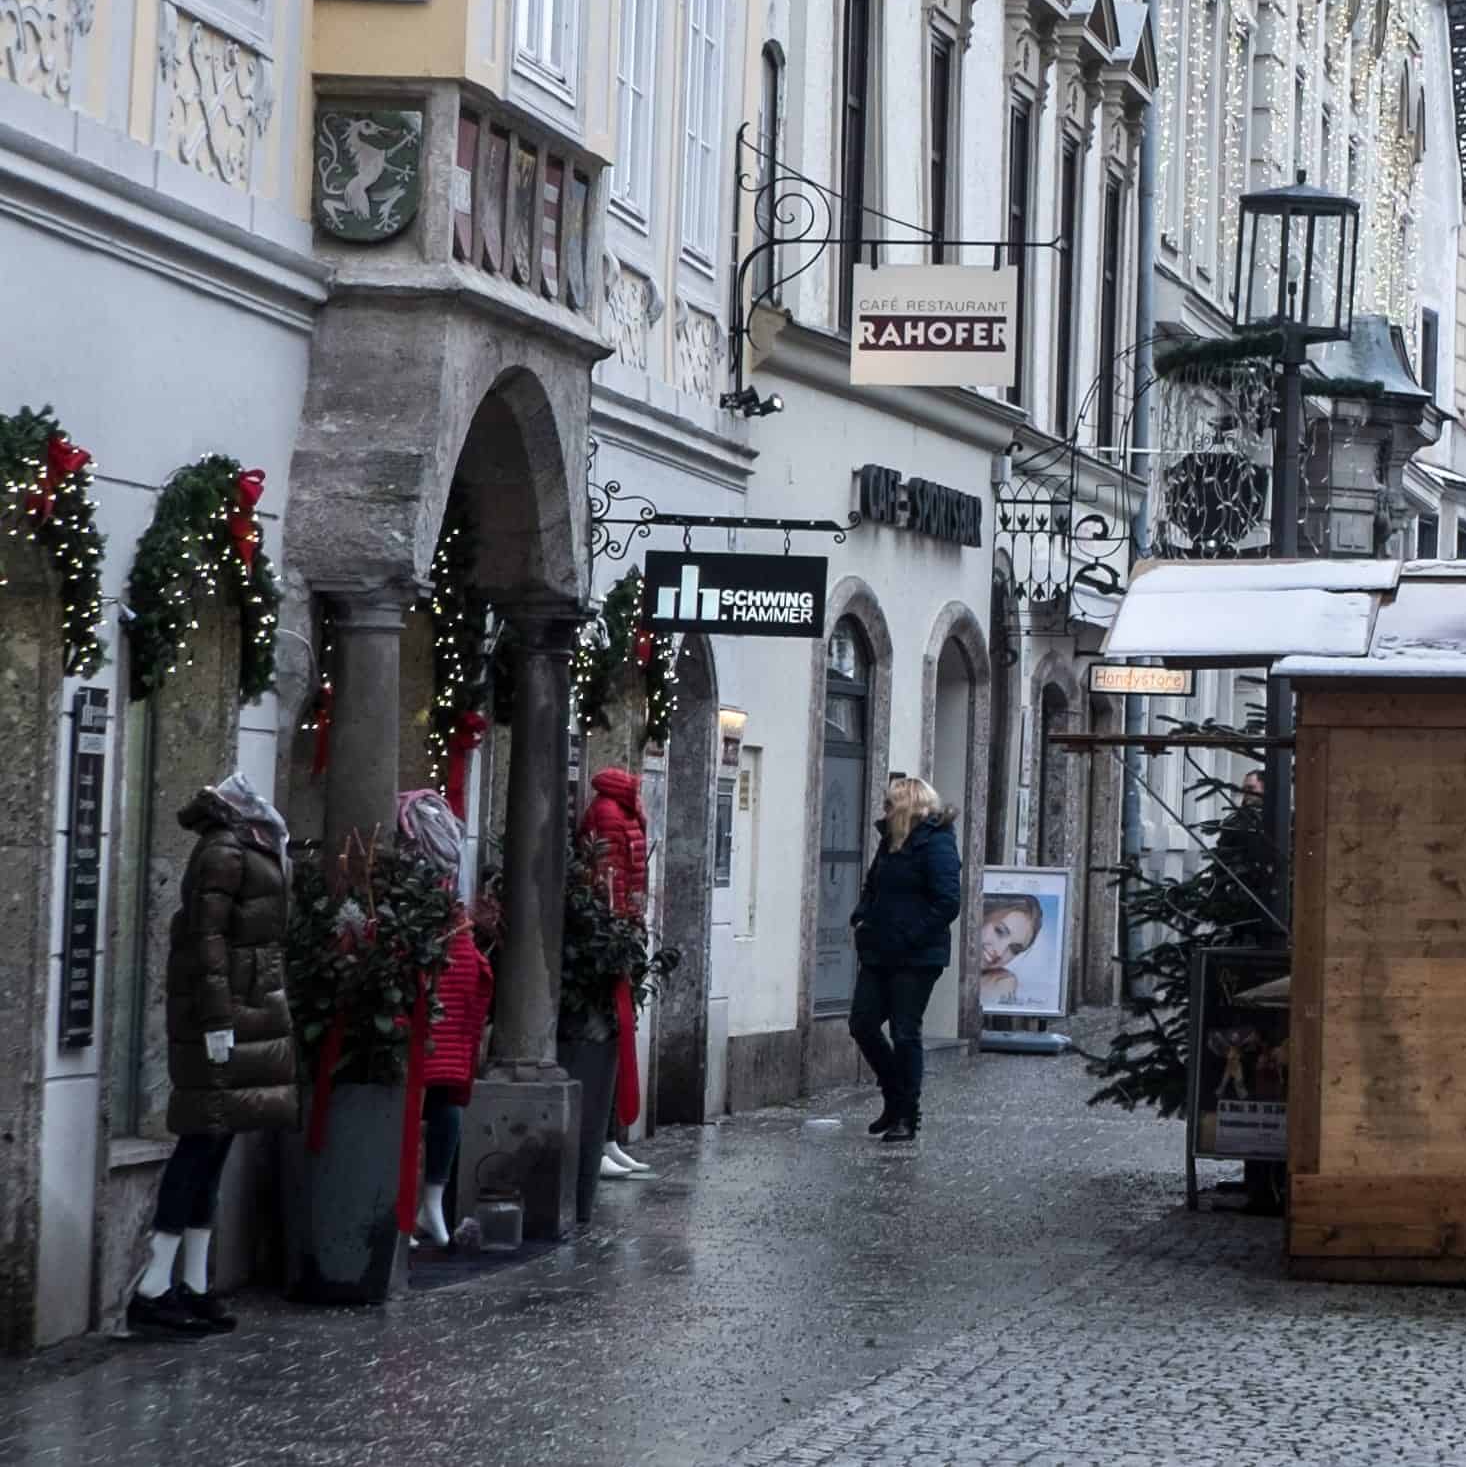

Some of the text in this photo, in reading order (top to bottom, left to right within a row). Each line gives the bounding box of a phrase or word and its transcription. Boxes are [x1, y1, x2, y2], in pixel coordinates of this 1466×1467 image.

[859, 297, 1008, 312] CAFÉ RESTAURANT
[859, 321, 1006, 346] RAHOFER
[721, 589, 814, 608] SCHWING
[732, 606, 813, 624] HAMMER
